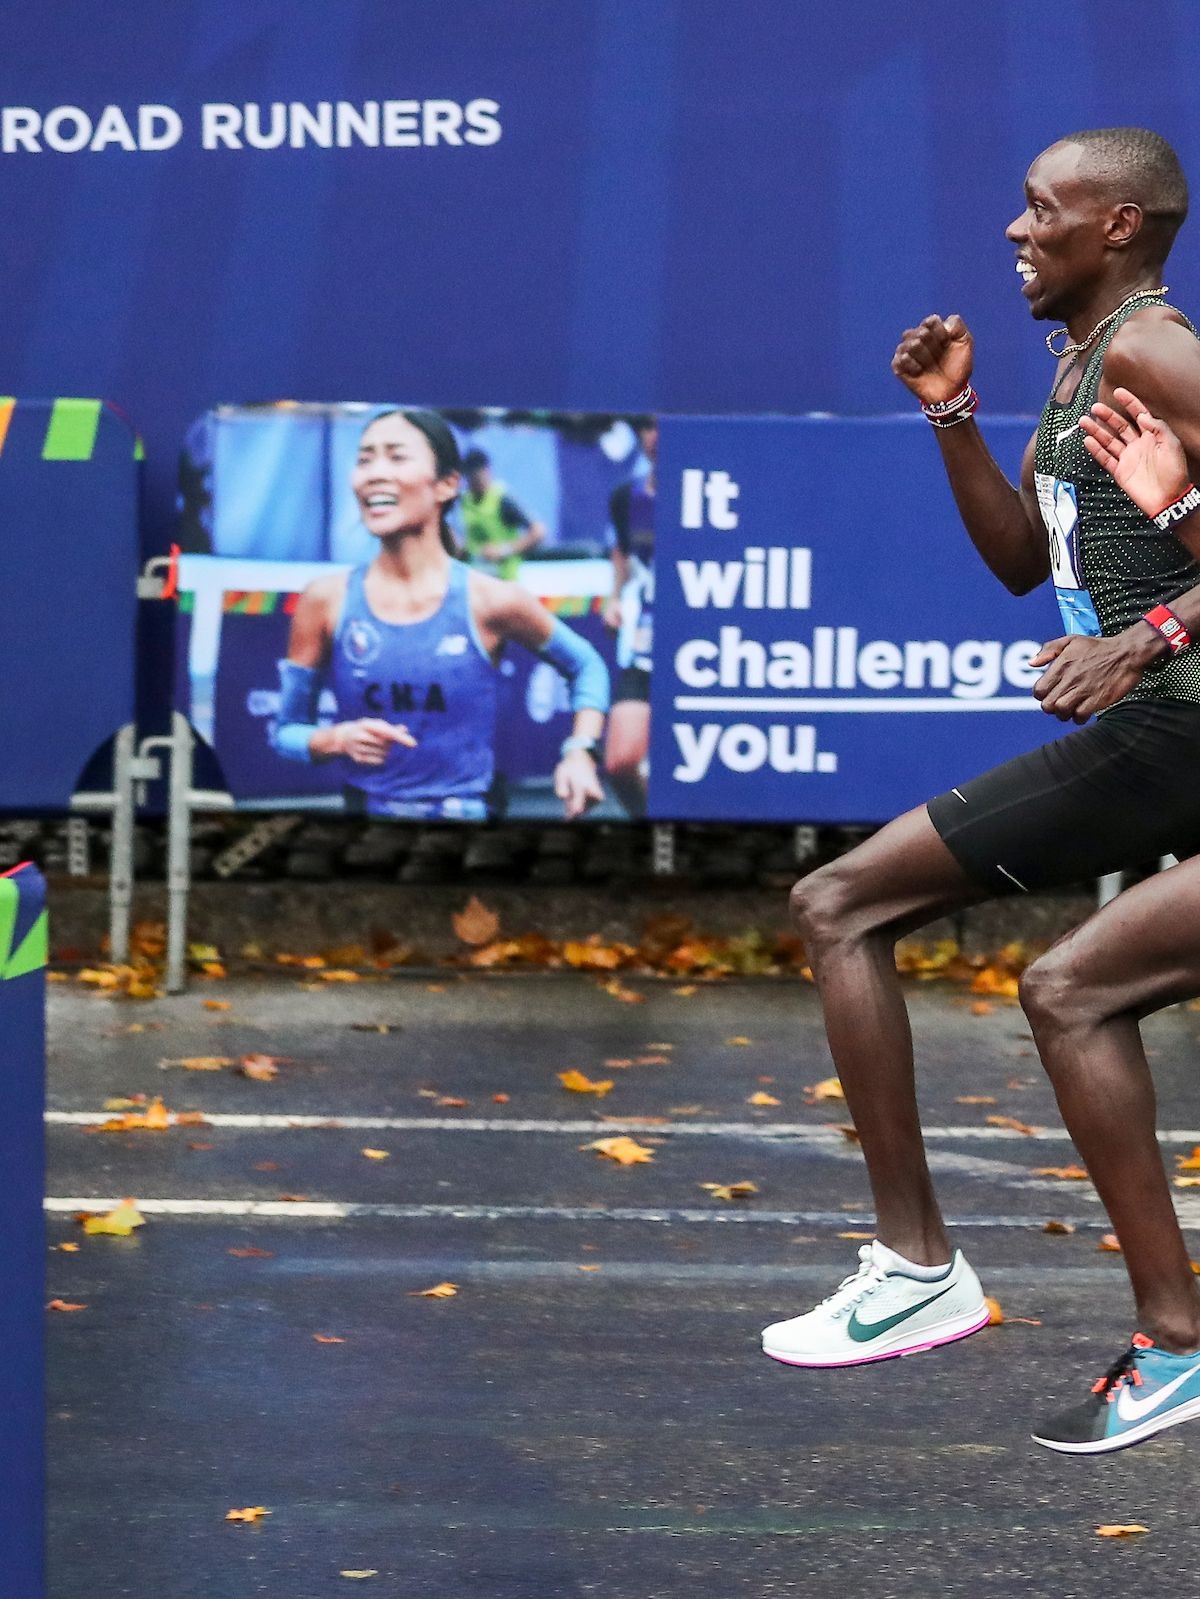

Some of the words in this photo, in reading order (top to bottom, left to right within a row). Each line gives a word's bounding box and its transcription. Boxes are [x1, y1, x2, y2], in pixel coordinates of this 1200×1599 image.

[1, 104, 184, 154] ROAD
[201, 98, 503, 150] RUNNERS
[680, 468, 740, 530] It
[675, 547, 812, 610] will
[674, 625, 1045, 700] challenge
[672, 723, 838, 783] you.
